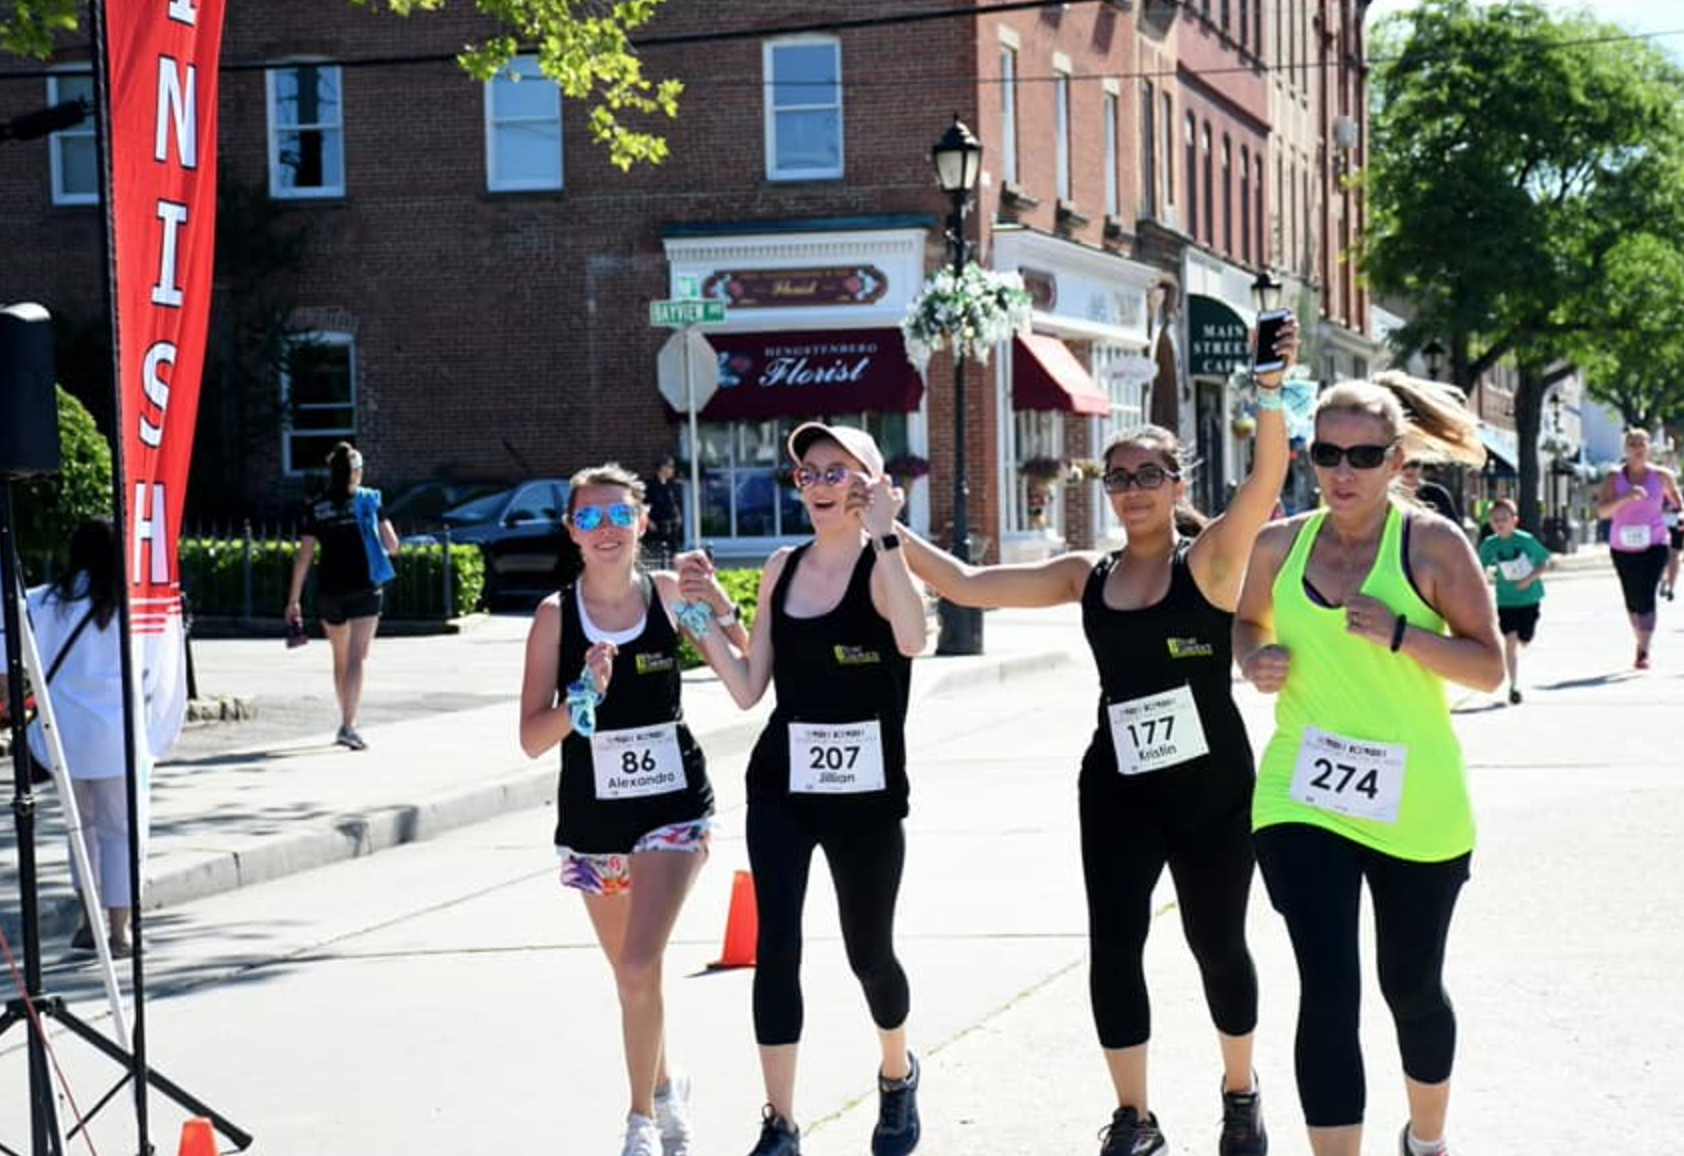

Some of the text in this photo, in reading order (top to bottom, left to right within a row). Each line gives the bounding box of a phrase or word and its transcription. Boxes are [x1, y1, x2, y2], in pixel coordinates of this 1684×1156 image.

[1203, 324, 1244, 338] MAIN
[758, 357, 870, 387] Florist
[1127, 715, 1175, 748] 177
[622, 749, 656, 774] 86
[809, 746, 860, 770] 207
[1139, 744, 1178, 760] Kristin
[607, 772, 675, 789] Alexandra
[819, 771, 855, 783] Jillian
[1310, 758, 1378, 799] 274
